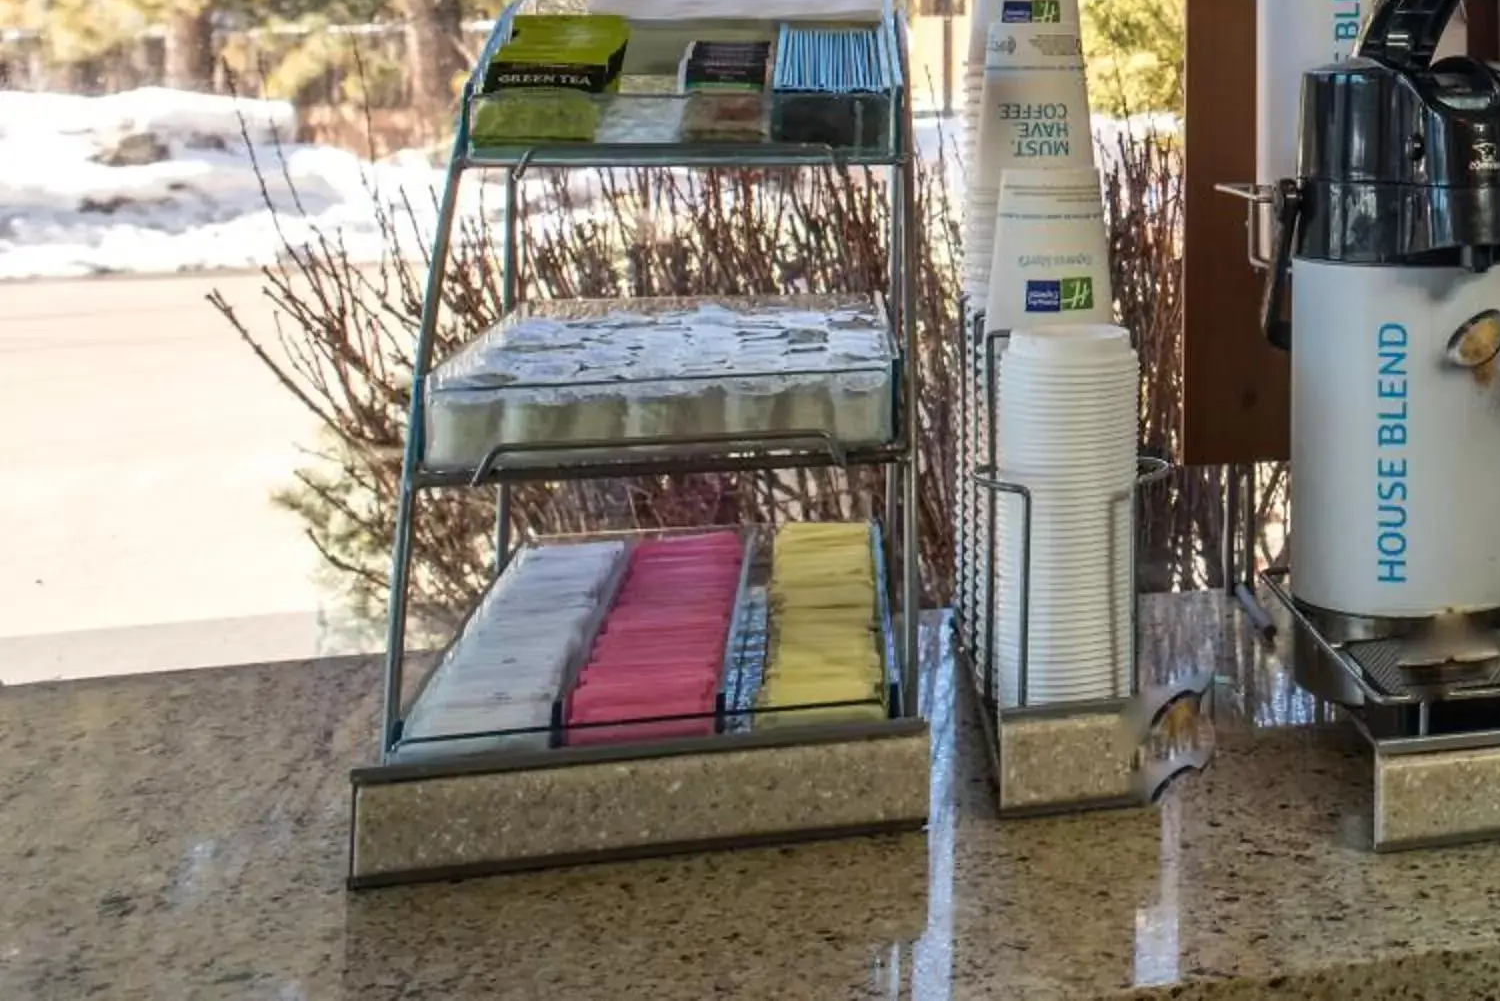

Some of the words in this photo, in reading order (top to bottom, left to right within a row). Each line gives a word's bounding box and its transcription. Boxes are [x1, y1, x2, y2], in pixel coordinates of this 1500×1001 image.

[498, 73, 556, 85] GREEN
[559, 73, 592, 86] TEA
[1377, 321, 1410, 448] BLEND
[1376, 458, 1409, 585] HOUSE
